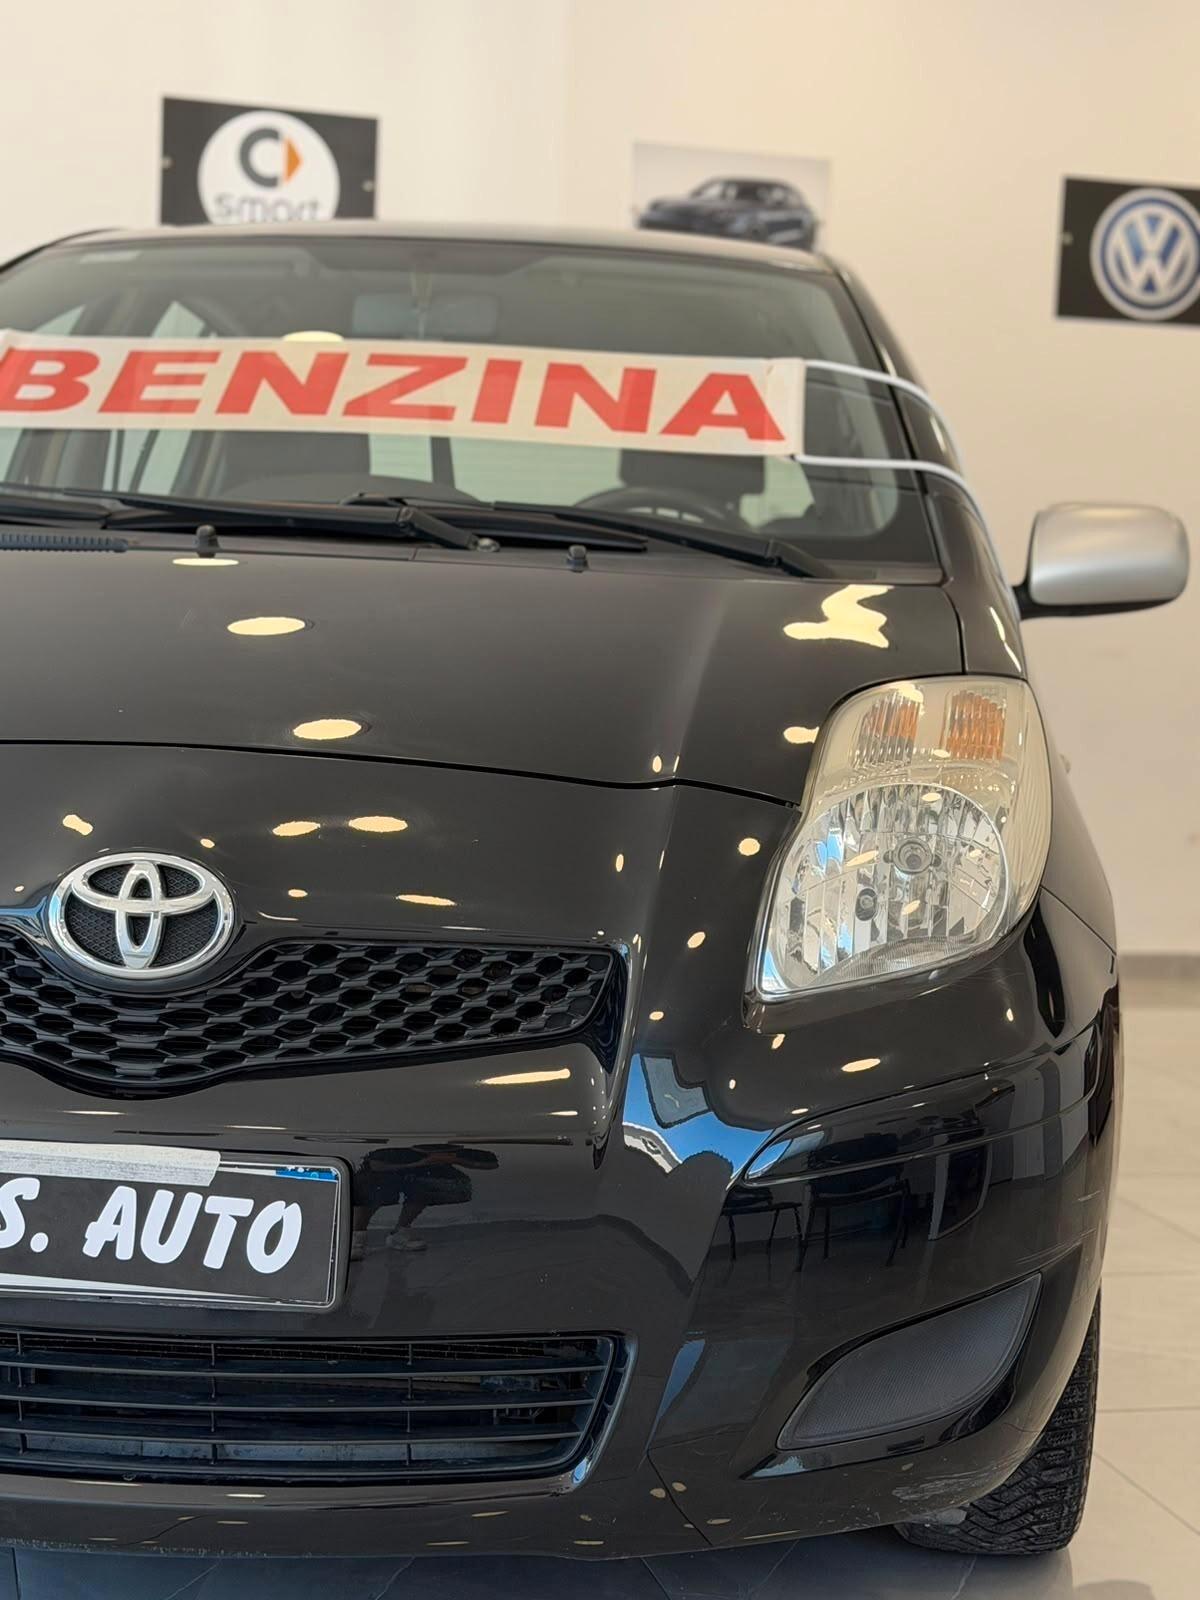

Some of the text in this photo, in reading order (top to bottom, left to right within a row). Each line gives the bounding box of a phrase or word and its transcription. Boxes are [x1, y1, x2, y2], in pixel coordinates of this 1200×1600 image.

[213, 194, 321, 222] smart
[0, 347, 786, 441] BENZINA
[0, 1177, 302, 1274] S. AUTO
